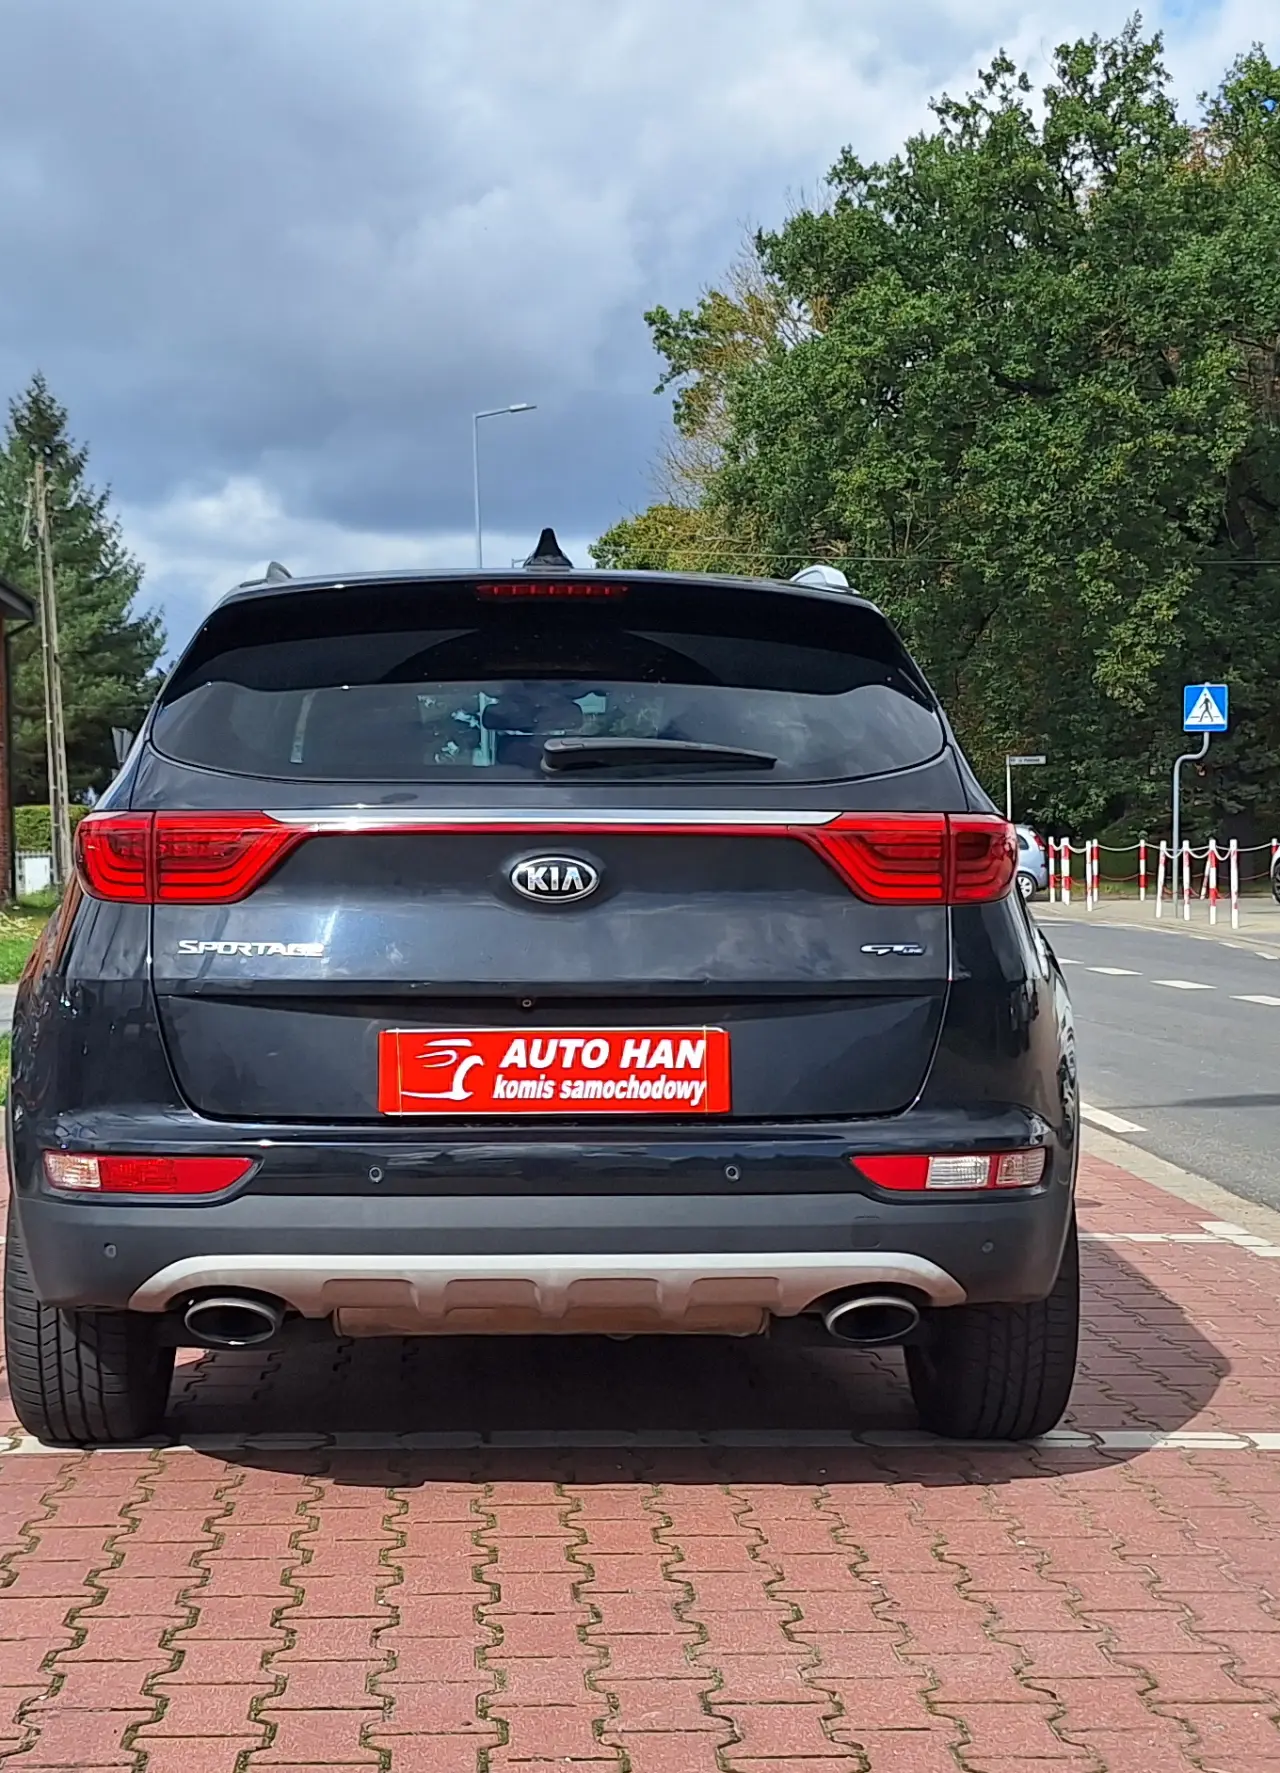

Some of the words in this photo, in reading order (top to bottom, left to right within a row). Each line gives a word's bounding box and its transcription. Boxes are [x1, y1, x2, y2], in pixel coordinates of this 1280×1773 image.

[526, 866, 584, 891] KIA
[177, 940, 324, 957] SPORTAGE
[499, 1038, 610, 1069] AUTO
[618, 1038, 707, 1069] HAN
[492, 1074, 555, 1100] komis
[559, 1074, 707, 1106] samochodowy
